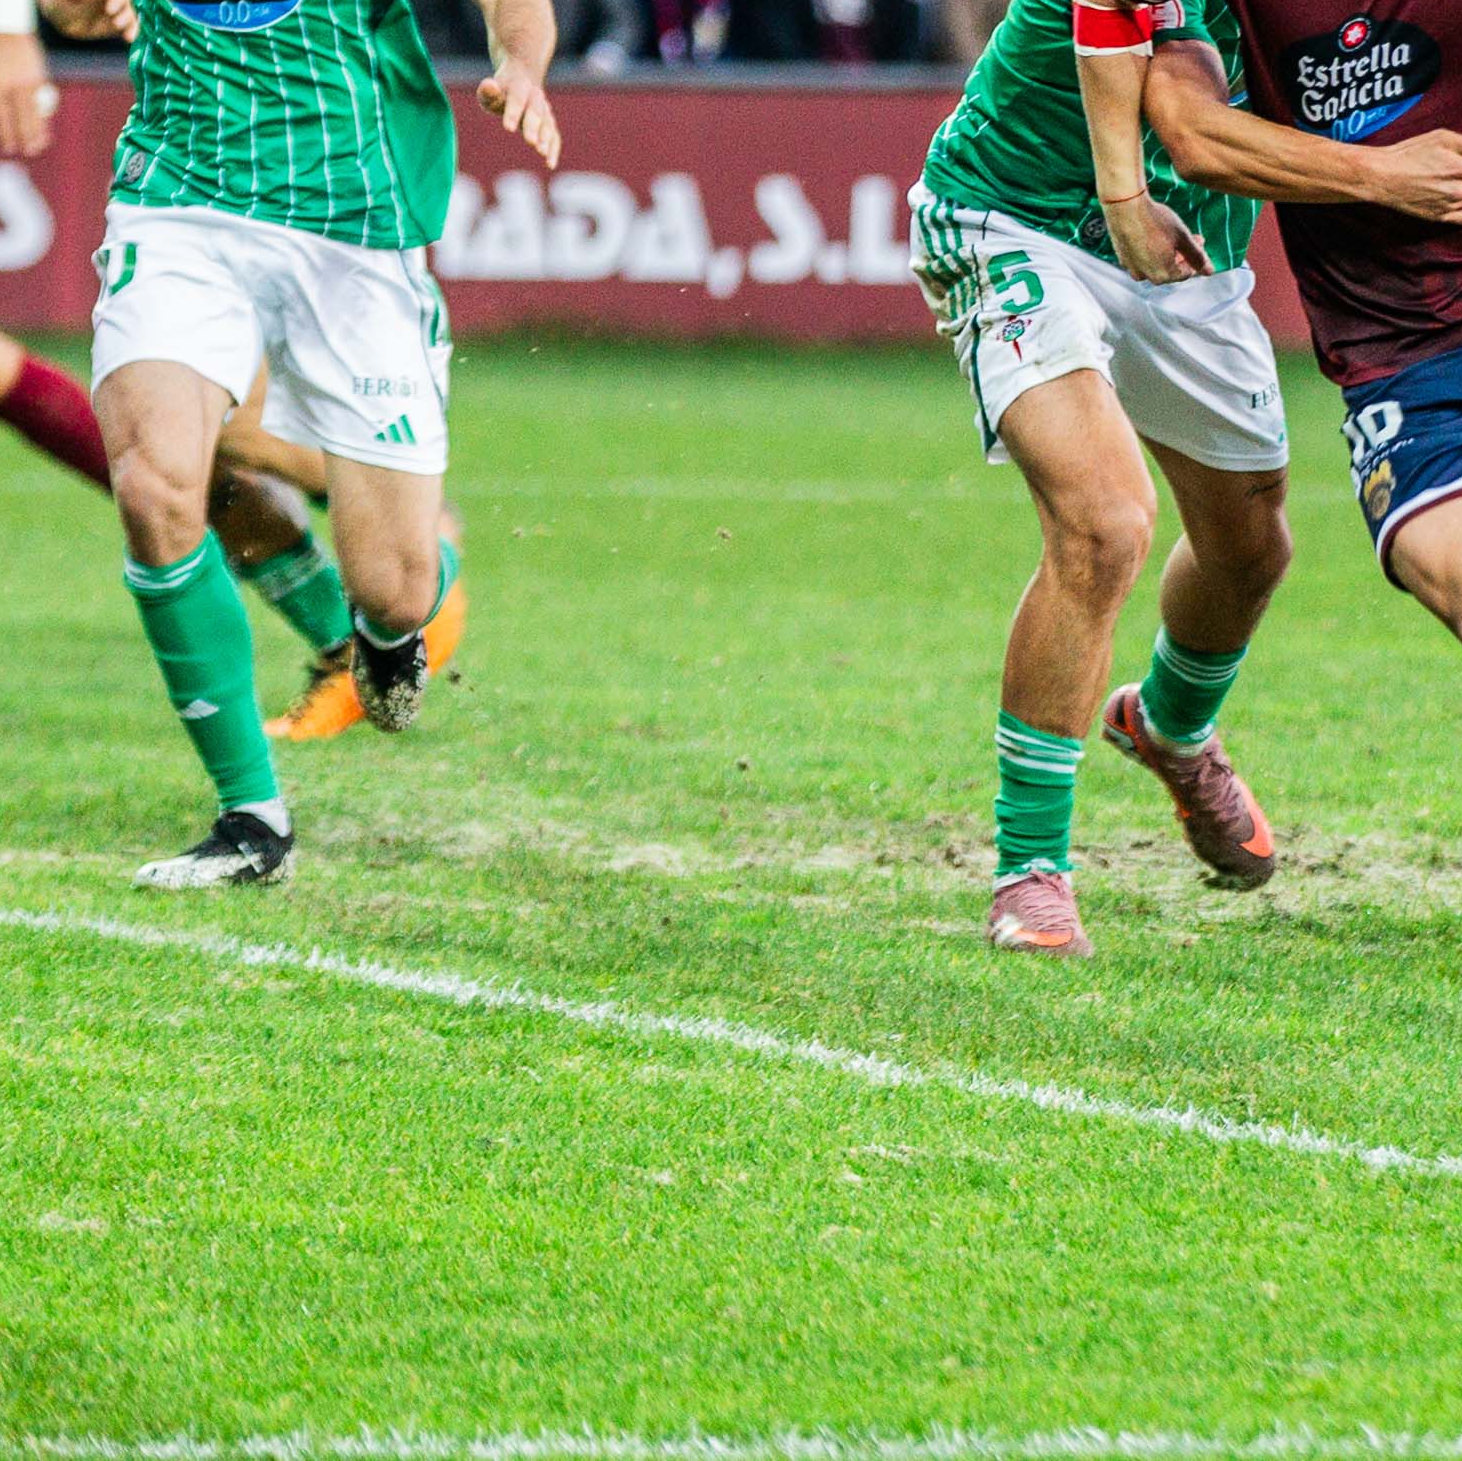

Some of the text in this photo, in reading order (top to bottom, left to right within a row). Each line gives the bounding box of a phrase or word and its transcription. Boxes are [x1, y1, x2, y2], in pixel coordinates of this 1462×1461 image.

[1296, 42, 1411, 88] Estrella
[1301, 72, 1405, 122] Galicia
[987, 250, 1044, 314] 5
